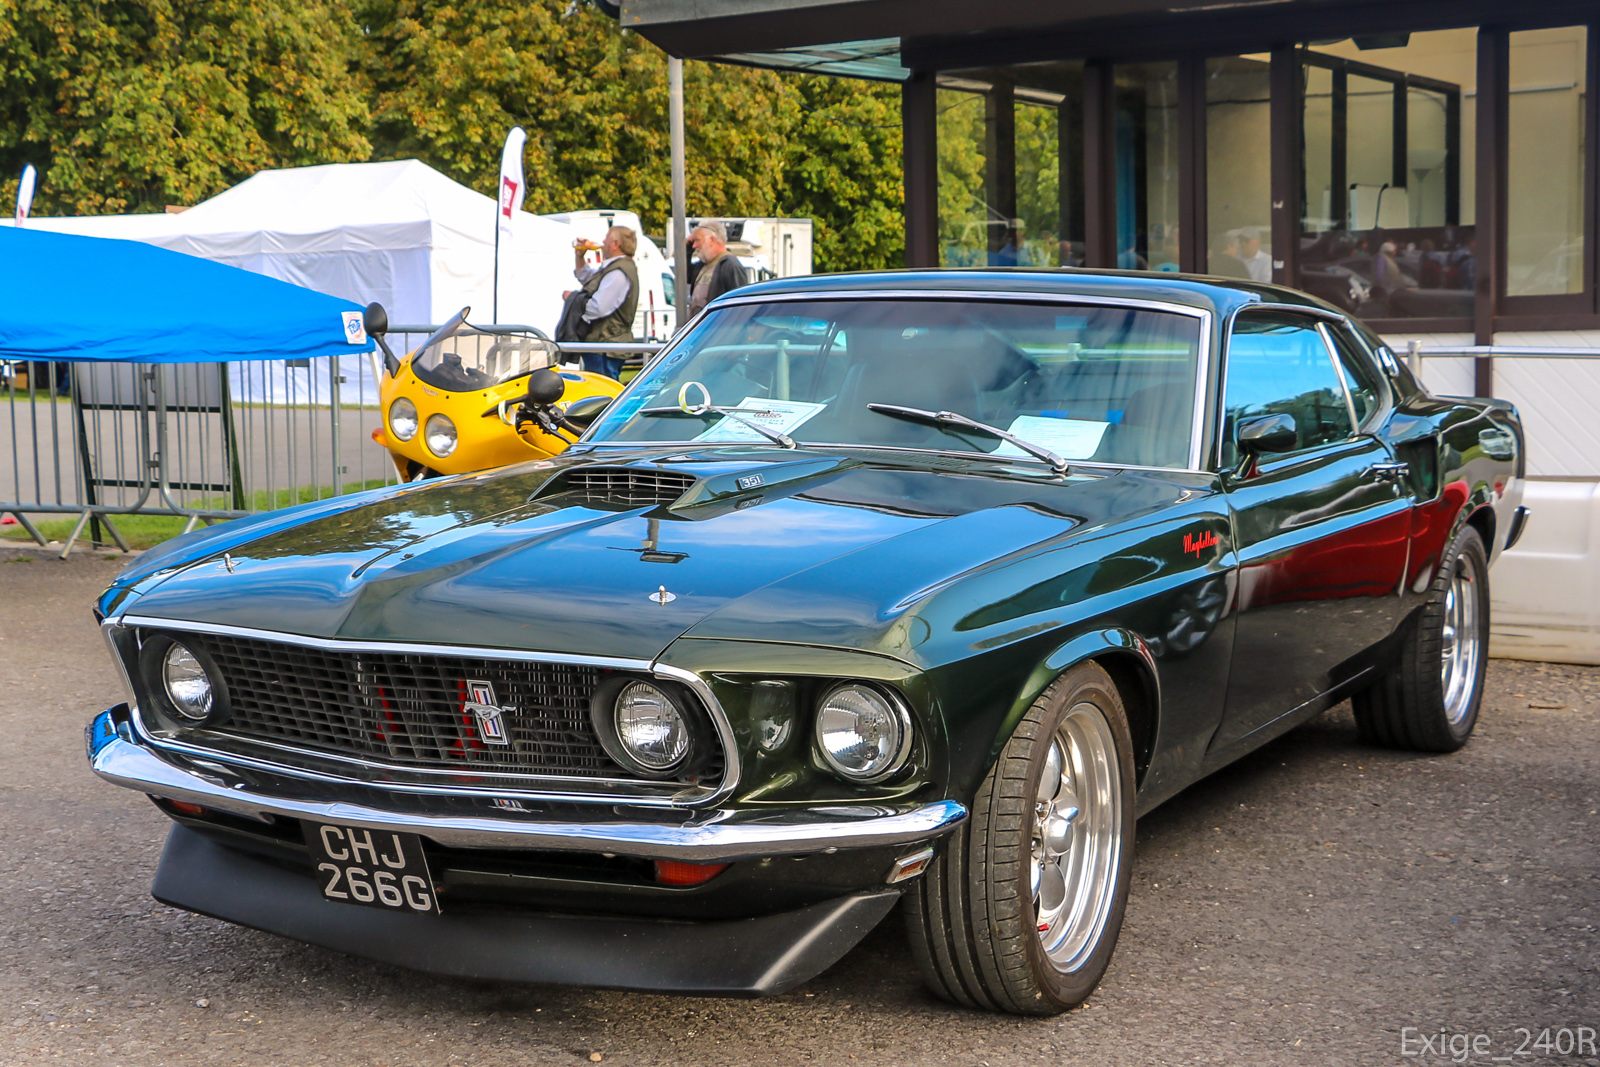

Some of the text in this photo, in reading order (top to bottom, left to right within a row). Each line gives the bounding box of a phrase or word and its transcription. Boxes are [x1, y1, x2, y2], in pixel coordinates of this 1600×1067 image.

[742, 475, 761, 487] 351
[320, 825, 405, 868] CHJ
[318, 863, 431, 911] 266G
